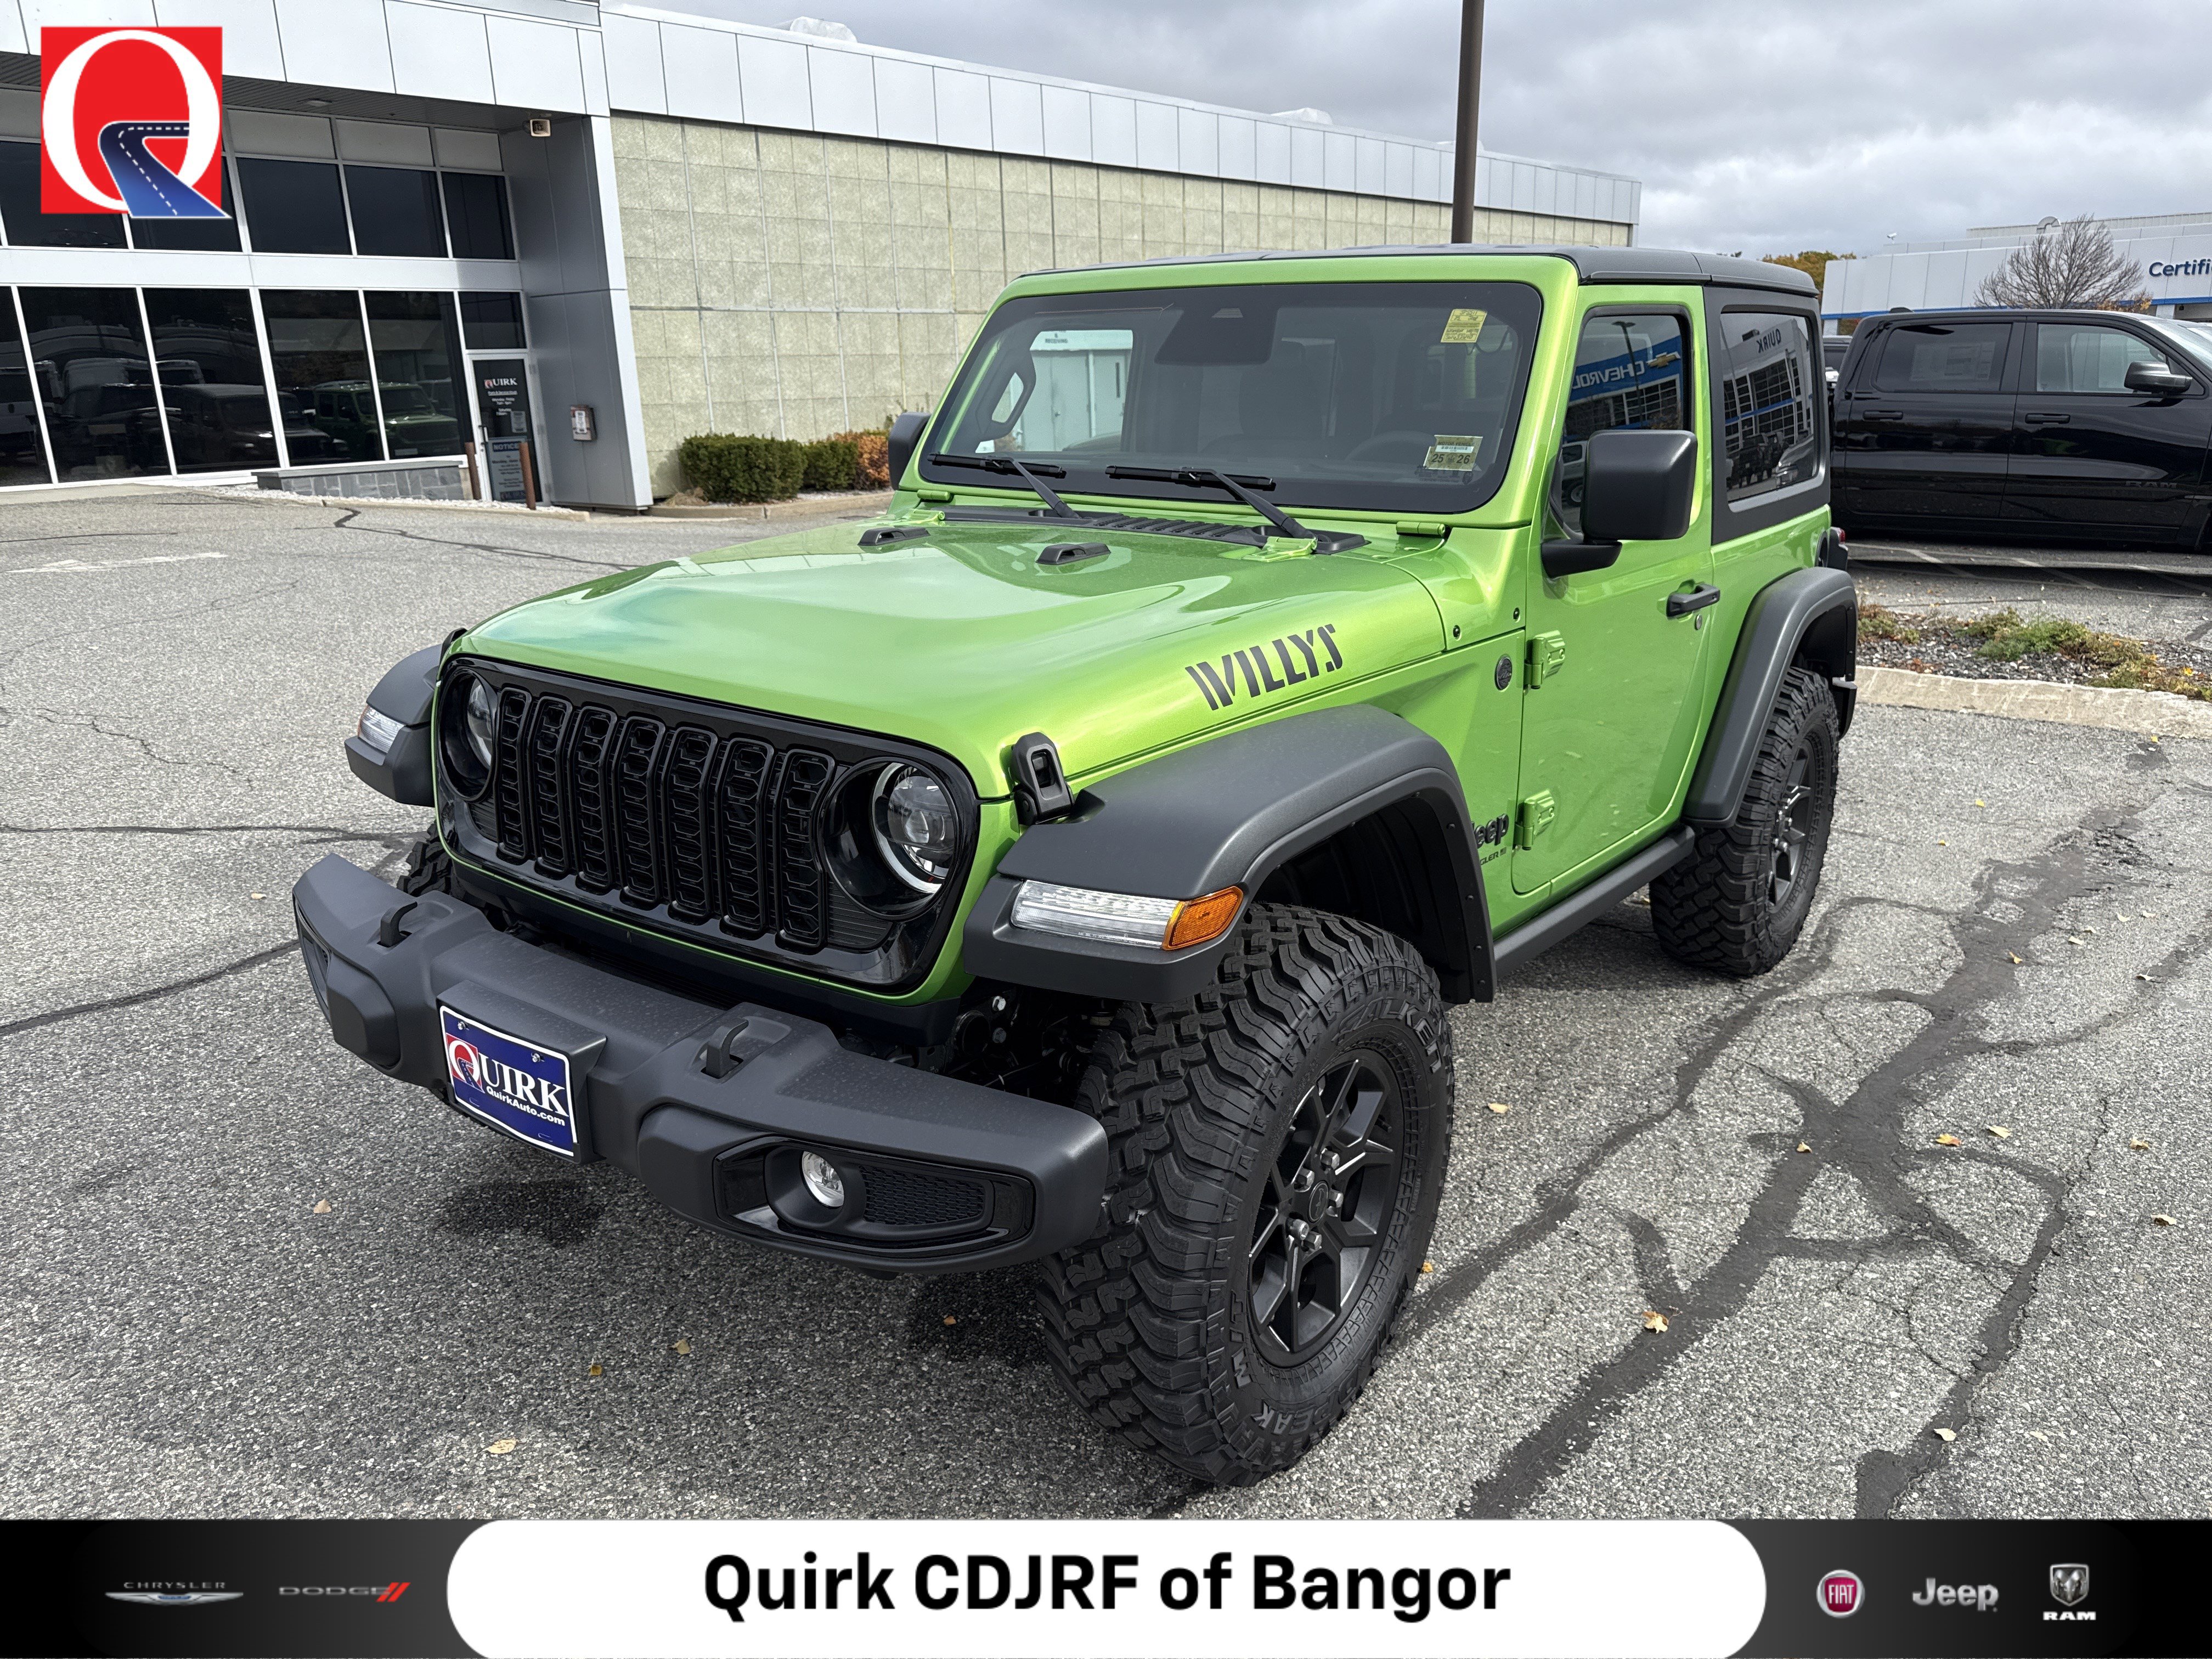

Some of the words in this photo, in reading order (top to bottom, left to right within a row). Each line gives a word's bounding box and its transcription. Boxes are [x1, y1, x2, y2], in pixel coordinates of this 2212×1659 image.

[2149, 258, 2212, 276] Certifi
[484, 377, 518, 390] QUIRK
[1431, 453, 1445, 463] 25
[1456, 454, 1471, 464] 26
[1184, 623, 1343, 711] WILLYS
[1471, 813, 1509, 849] eep
[1480, 851, 1499, 865] GLER
[448, 1039, 569, 1118] QUIRK
[486, 1086, 566, 1126] QuirkAuto.com
